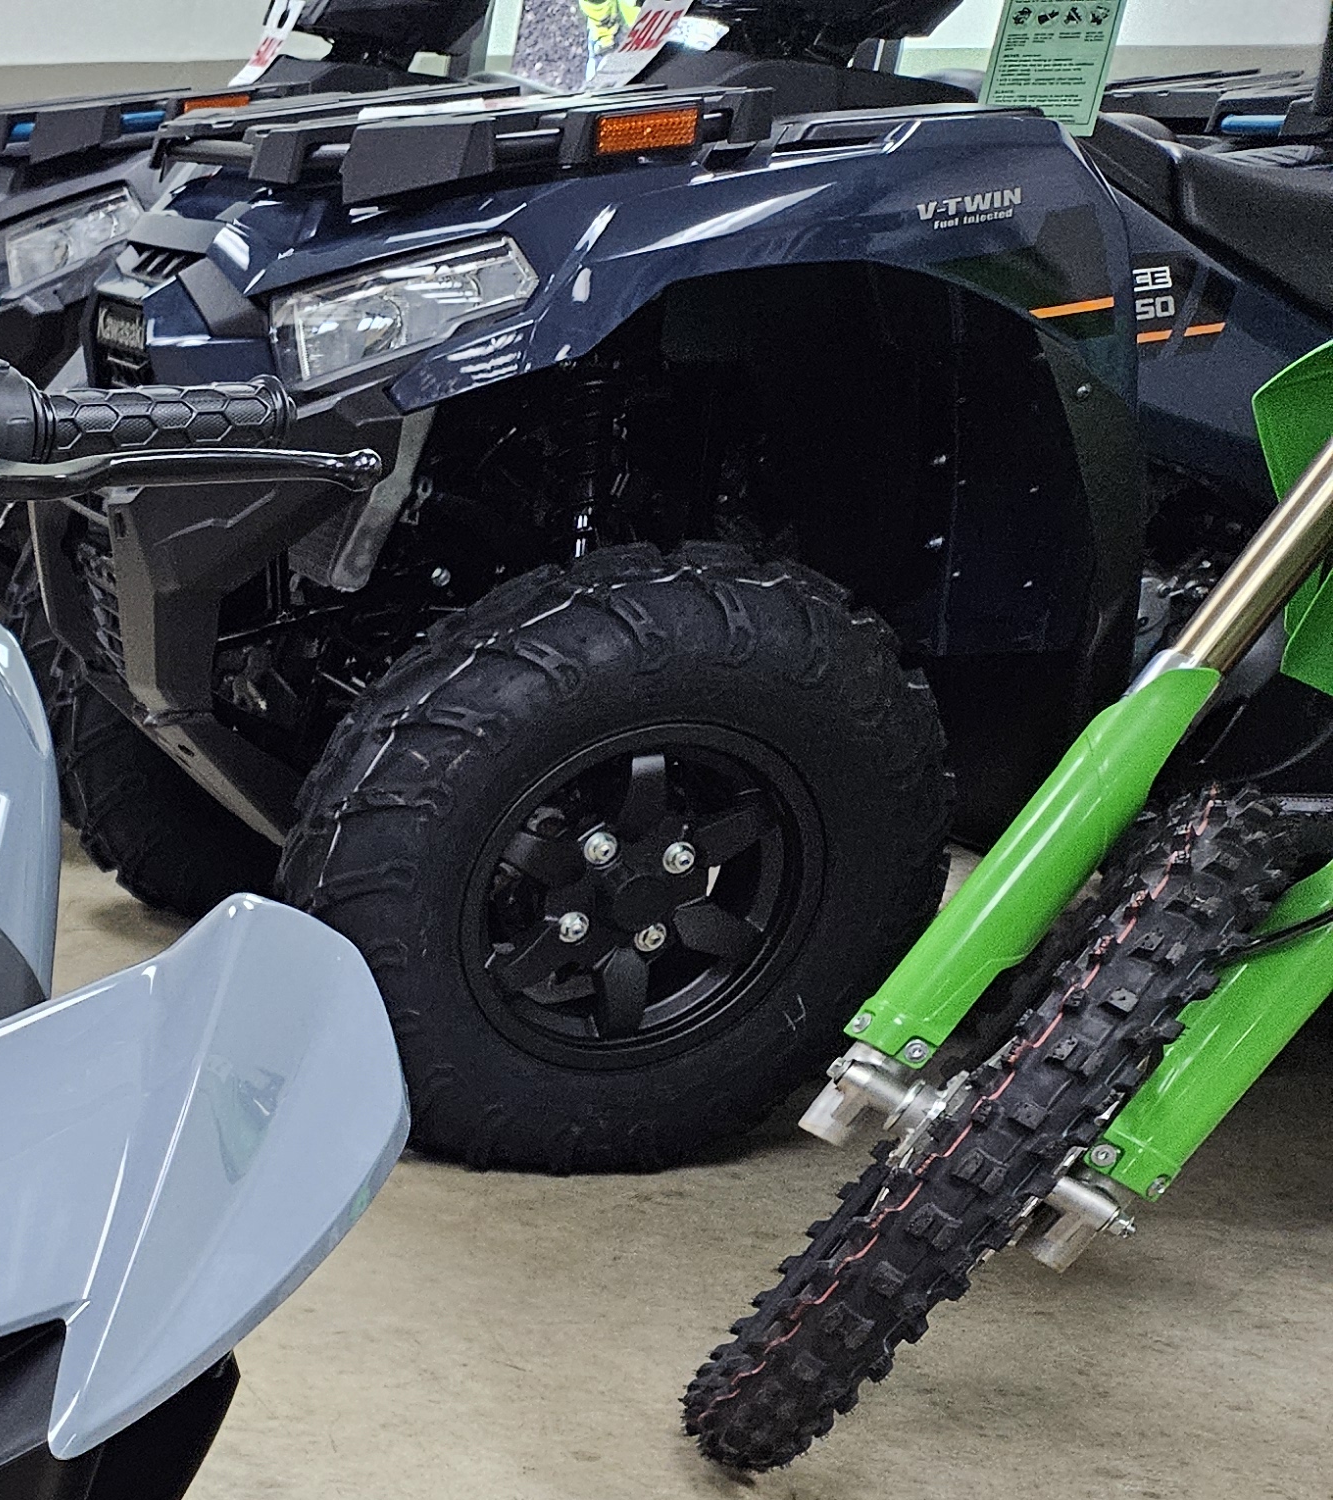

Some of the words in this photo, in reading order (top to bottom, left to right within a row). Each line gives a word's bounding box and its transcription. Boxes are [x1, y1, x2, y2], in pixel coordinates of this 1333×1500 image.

[917, 187, 1022, 221] V-TWIN
[934, 217, 960, 230] Fuel
[963, 208, 1014, 225] Injected
